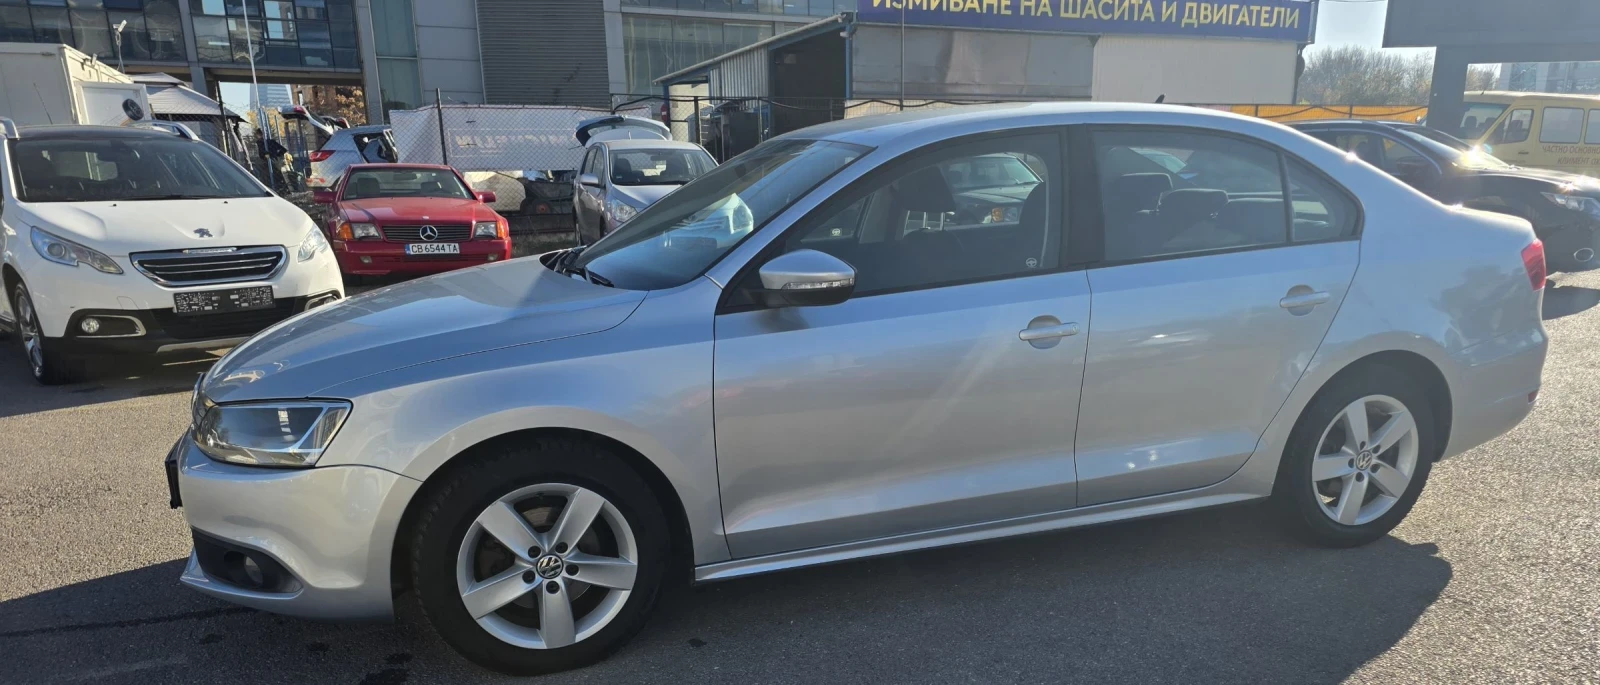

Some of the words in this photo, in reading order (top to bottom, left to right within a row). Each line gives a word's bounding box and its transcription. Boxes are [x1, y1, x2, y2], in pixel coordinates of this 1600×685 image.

[1019, 0, 1053, 17] НА
[1059, 0, 1156, 22] ШАСИТА
[1161, 1, 1177, 23] И
[1181, 2, 1300, 28] ДВИГАТЕЛИ
